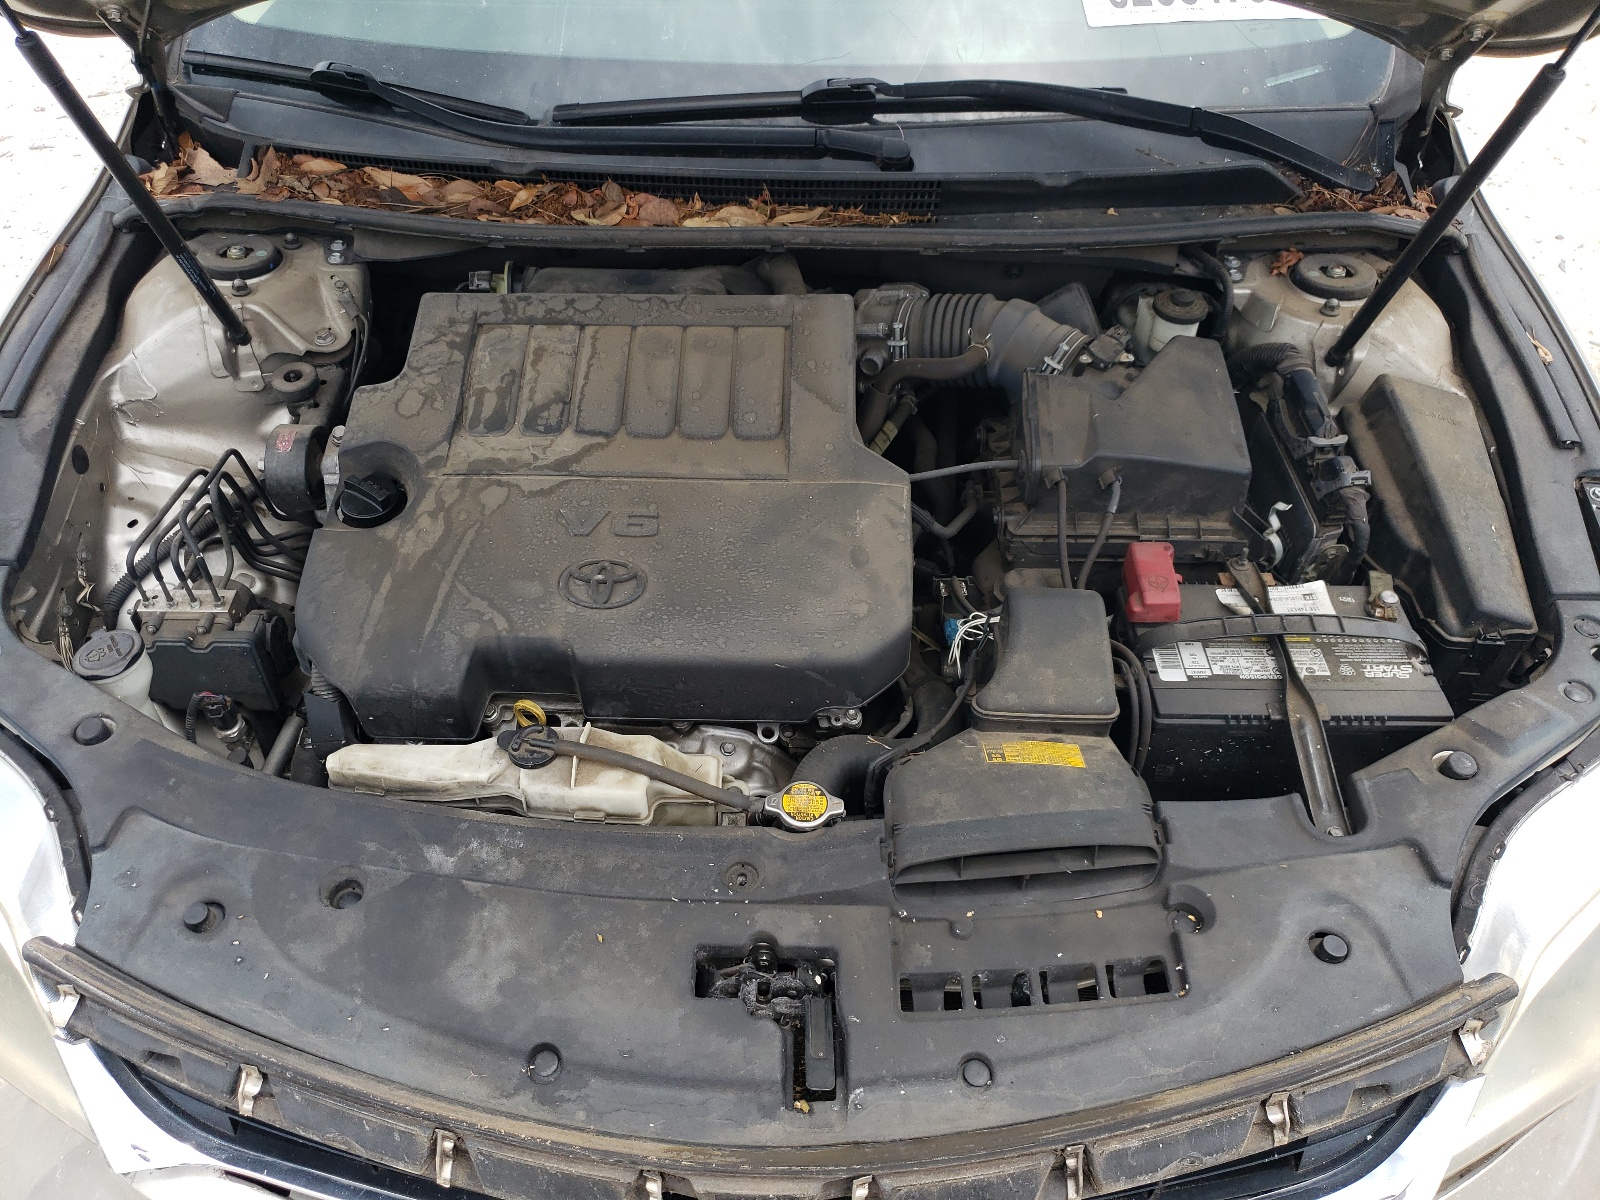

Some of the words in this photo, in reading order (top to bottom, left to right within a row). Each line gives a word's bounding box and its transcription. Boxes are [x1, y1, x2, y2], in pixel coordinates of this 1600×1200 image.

[558, 509, 659, 538] V6
[1362, 664, 1413, 673] START
[1364, 671, 1410, 679] SUPER
